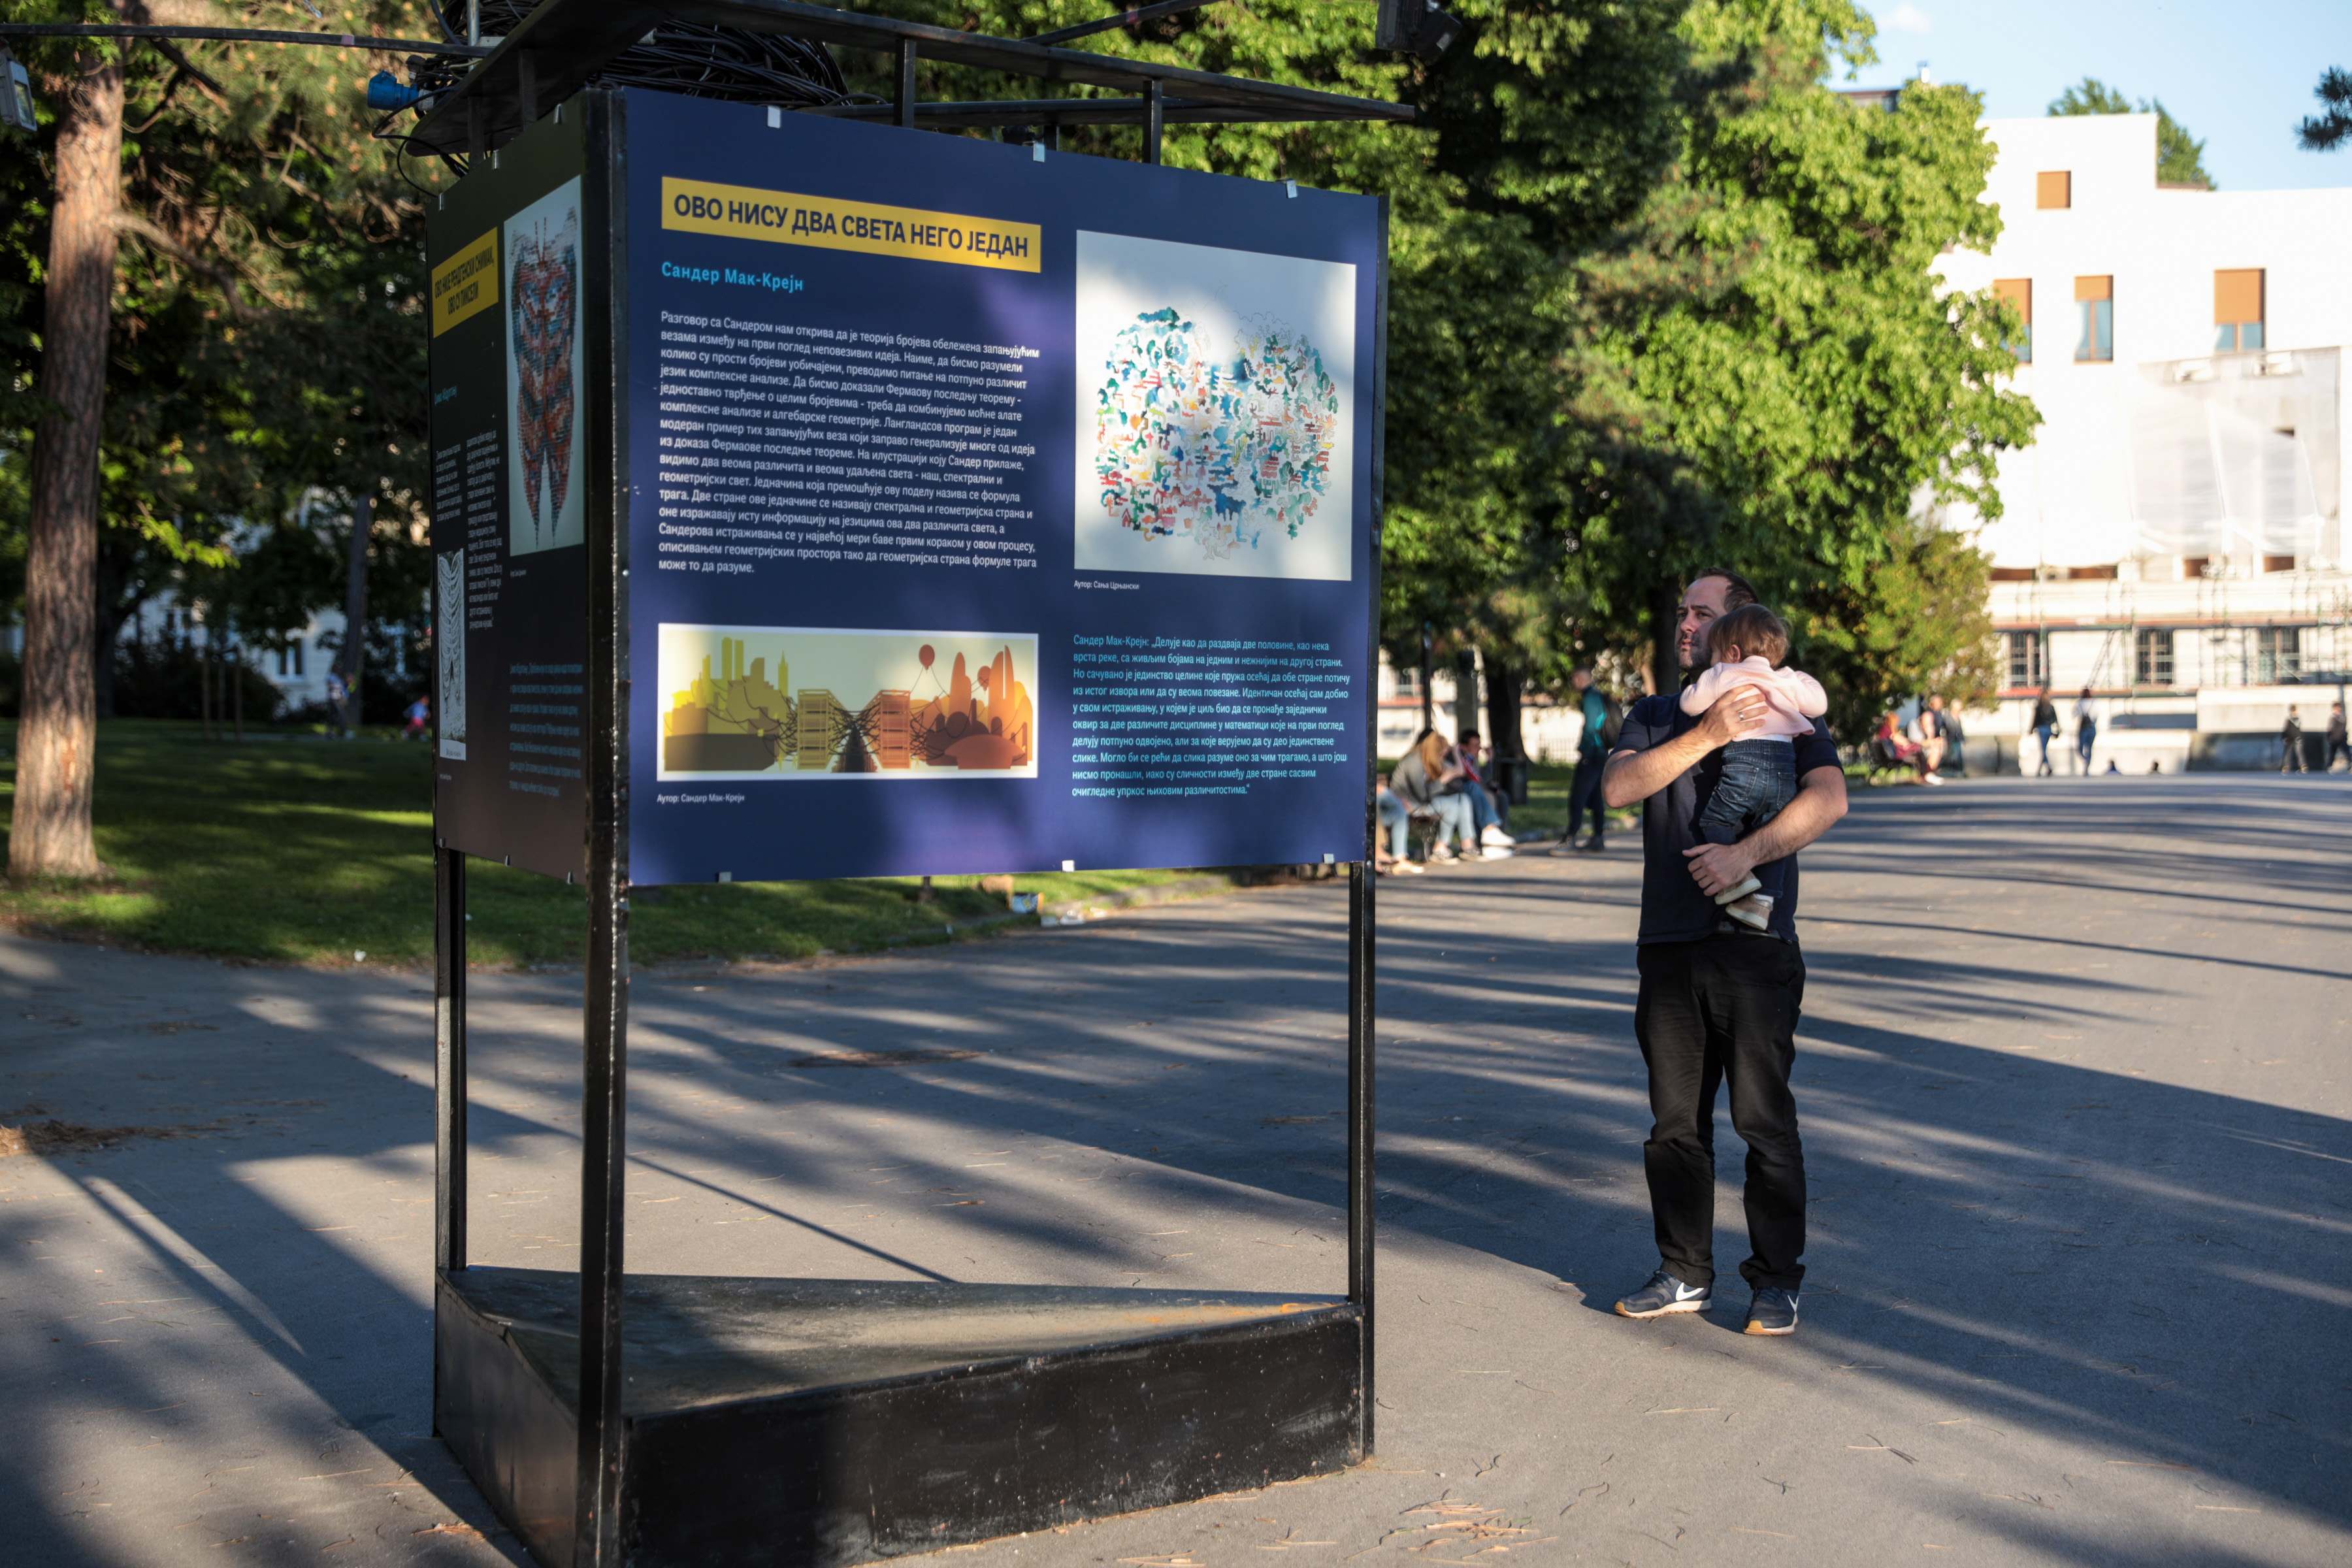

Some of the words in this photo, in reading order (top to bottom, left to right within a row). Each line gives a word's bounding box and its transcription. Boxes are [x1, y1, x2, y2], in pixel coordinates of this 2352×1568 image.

[674, 194, 723, 221] ОВО
[728, 201, 788, 227] НИСУ
[792, 208, 837, 236] ДВА
[841, 216, 906, 243] СВЕТА
[911, 223, 963, 250] НЕГО
[967, 231, 1028, 259] ЈЕДАН
[661, 261, 719, 285] Сандер
[725, 268, 802, 293] Мак-Крејн
[661, 310, 708, 328] Разговор
[710, 318, 721, 327] са
[723, 317, 772, 333] Сандером
[775, 325, 793, 334] нам
[796, 327, 833, 338] открива
[835, 331, 847, 340] да
[849, 329, 857, 342] је
[859, 333, 894, 346] теорија
[896, 334, 930, 348] бројева
[932, 338, 981, 352] обележена
[983, 344, 1039, 359] запањујућим
[661, 331, 696, 342] везама
[699, 334, 735, 348] између
[737, 338, 749, 347] на
[751, 339, 775, 351] први
[777, 342, 810, 354] поглед
[813, 346, 872, 358] неповезивих
[875, 350, 901, 363] идеја.
[904, 351, 935, 366] Наиме,
[937, 357, 948, 367] да
[950, 355, 978, 368] бисмо
[980, 361, 1022, 372] разумели
[661, 349, 696, 360] колико
[698, 351, 710, 364] су
[712, 353, 746, 365] прости
[749, 353, 786, 369] бројеви
[789, 358, 843, 374] уобичајени,
[846, 365, 898, 378] преводимо
[900, 370, 933, 381] питање
[936, 373, 945, 382] на
[948, 374, 984, 387] потпуно
[986, 378, 1026, 389] различит
[660, 401, 719, 414] комплексне
[721, 406, 761, 417] анализе
[772, 409, 826, 423] алгебарске
[828, 415, 881, 429] геометрије.
[883, 416, 941, 431] Лангландсов
[944, 423, 981, 436] програм
[983, 424, 990, 437] је
[992, 425, 1016, 438] један
[660, 436, 672, 446] из
[674, 437, 709, 449] доказа
[711, 438, 761, 452] Фермаове
[764, 444, 811, 456] последње
[813, 448, 855, 459] теореме.
[858, 448, 869, 459] На
[872, 451, 926, 465] илустрацији
[929, 453, 946, 467] коју
[948, 455, 981, 469] Сандер
[983, 459, 1023, 471] прилаже,
[659, 471, 726, 486] геометријски
[728, 476, 751, 486] свет.
[753, 476, 803, 489] Једначина
[806, 479, 825, 493] која
[827, 482, 882, 496] премошћује
[884, 485, 900, 497] ову
[902, 487, 934, 499] поделу
[936, 489, 966, 498] назива
[969, 491, 979, 499] се
[981, 489, 1019, 504] формула
[659, 542, 722, 553] описивањем
[725, 545, 794, 559] геометријских
[797, 549, 840, 561] простора
[843, 551, 863, 560] тако
[865, 551, 877, 562] да
[879, 551, 938, 565] геометријска
[939, 555, 970, 566] страна
[972, 554, 1011, 568] формуле
[1013, 558, 1036, 568] трага
[1073, 580, 1092, 589] Аутор:
[1110, 581, 1139, 590] Црњански
[1073, 634, 1103, 647] Сандер
[1106, 635, 1149, 648] Мак-Крејн:
[1197, 640, 1206, 648] да
[1209, 638, 1241, 650] раздваја
[1242, 641, 1256, 649] две
[1258, 641, 1295, 650] половине,
[1073, 653, 1096, 663] врста
[1098, 653, 1119, 664] реке,
[1168, 653, 1194, 665] бојама
[1206, 654, 1233, 666] једним
[1241, 655, 1277, 667] нежнијим
[1289, 657, 1313, 668] другој
[1315, 659, 1342, 668] страни.
[1073, 668, 1085, 678] Но
[1086, 670, 1123, 681] сачувано
[1124, 668, 1132, 681] је
[1134, 669, 1173, 681] јединство
[1175, 672, 1203, 681] целине
[1205, 670, 1220, 683] које
[1221, 673, 1245, 683] пружа
[1246, 671, 1269, 683] осећај
[1271, 674, 1280, 682] да
[1282, 672, 1296, 681] обе
[1297, 674, 1322, 683] стране
[1324, 675, 1350, 685] потичу
[1072, 720, 1097, 731] оквир
[1110, 721, 1125, 730] две
[1127, 721, 1168, 731] различите
[1169, 721, 1217, 730] дисциплине
[1218, 721, 1222, 731] у
[1224, 721, 1269, 730] математици
[1270, 719, 1286, 731] које
[1298, 722, 1316, 731] први
[1318, 722, 1344, 730] поглед
[1072, 771, 1098, 779] нисмо
[1100, 771, 1143, 781] пронашли,
[1166, 770, 1174, 780] су
[1218, 768, 1244, 779] између
[1245, 770, 1259, 779] две
[1261, 770, 1286, 779] стране
[657, 794, 679, 804] Аутор:
[681, 793, 707, 803] Сандер
[708, 793, 744, 803] Мак-Крејн
[1071, 787, 1115, 797] очигледне
[1117, 787, 1144, 798] упркос
